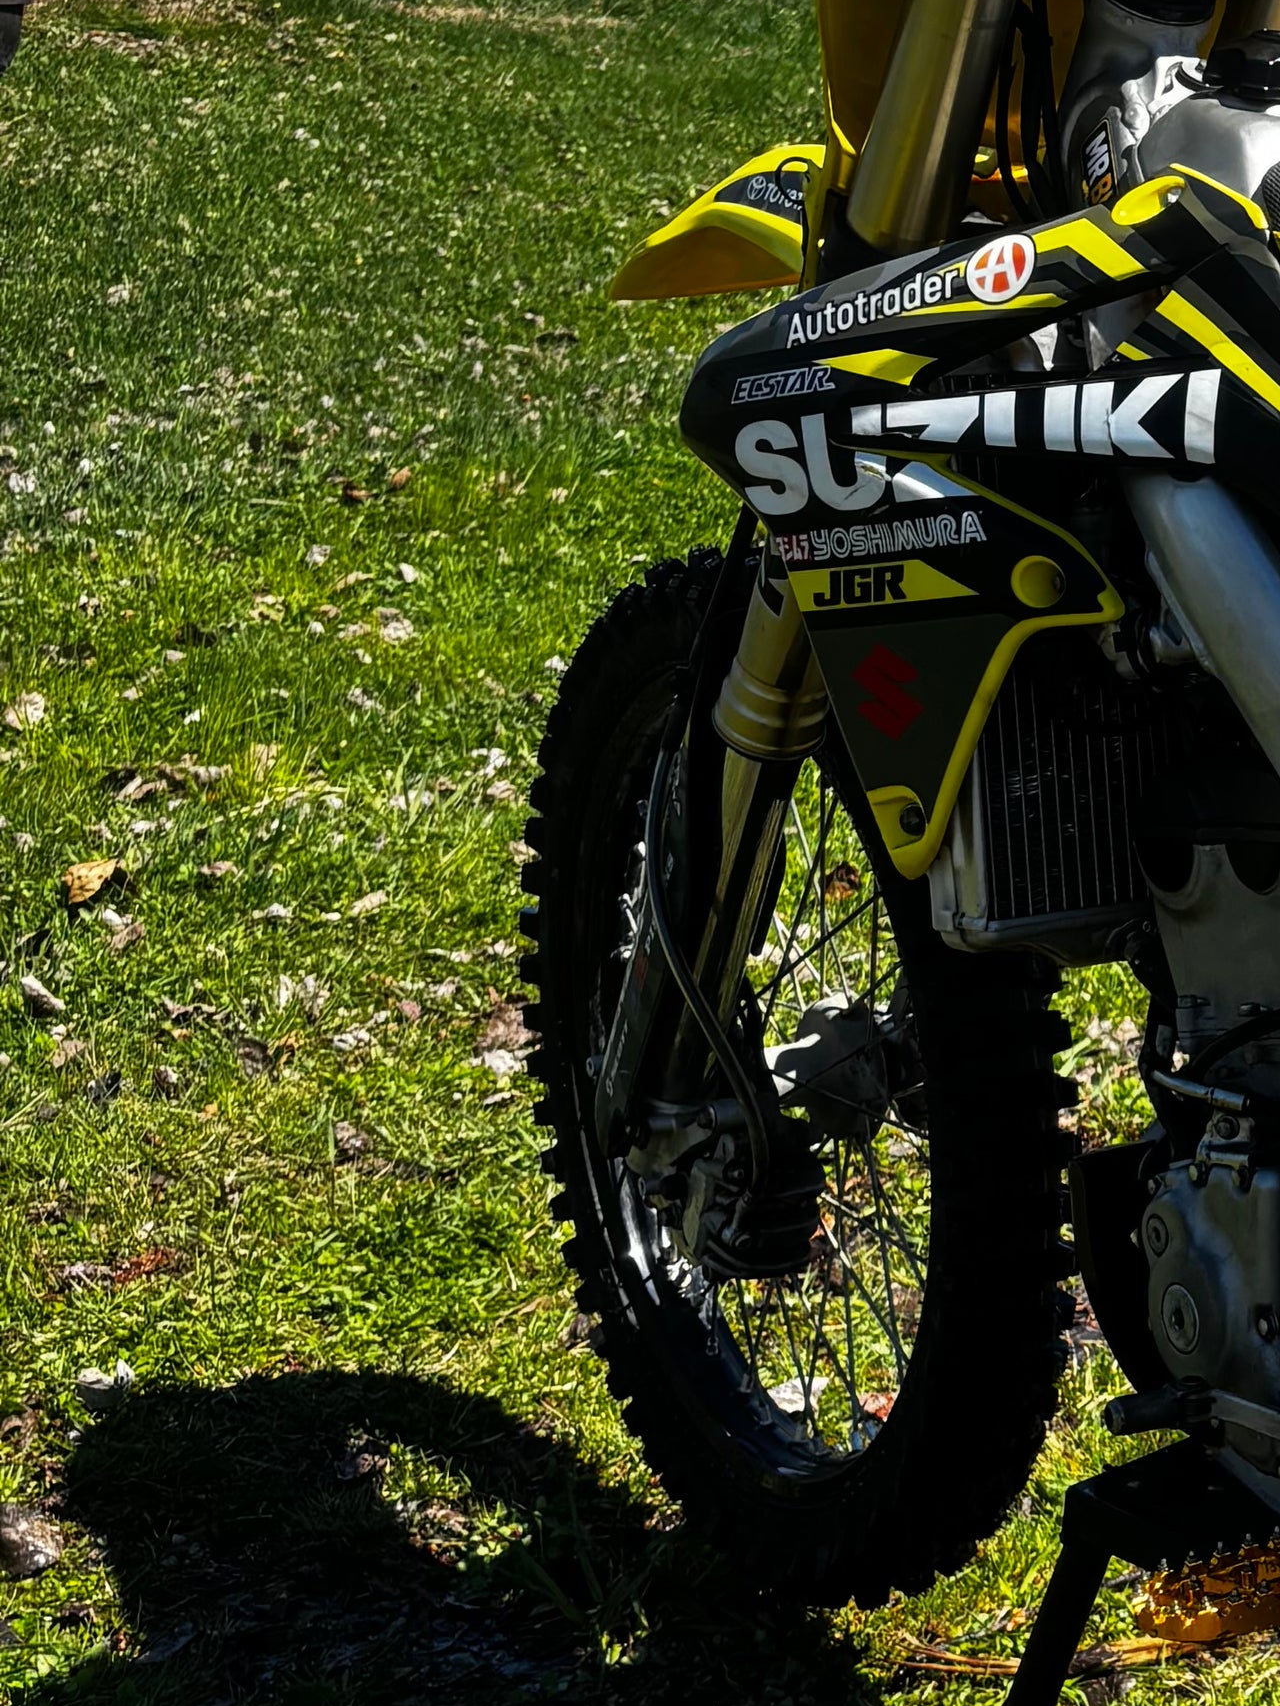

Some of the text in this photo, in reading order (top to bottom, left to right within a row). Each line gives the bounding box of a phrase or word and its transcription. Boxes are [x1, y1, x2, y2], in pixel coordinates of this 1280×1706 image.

[786, 271, 961, 349] Autotrader
[730, 365, 836, 405] ECSTAR
[810, 511, 987, 561] YOSHIMURA
[813, 564, 906, 607] JGR
